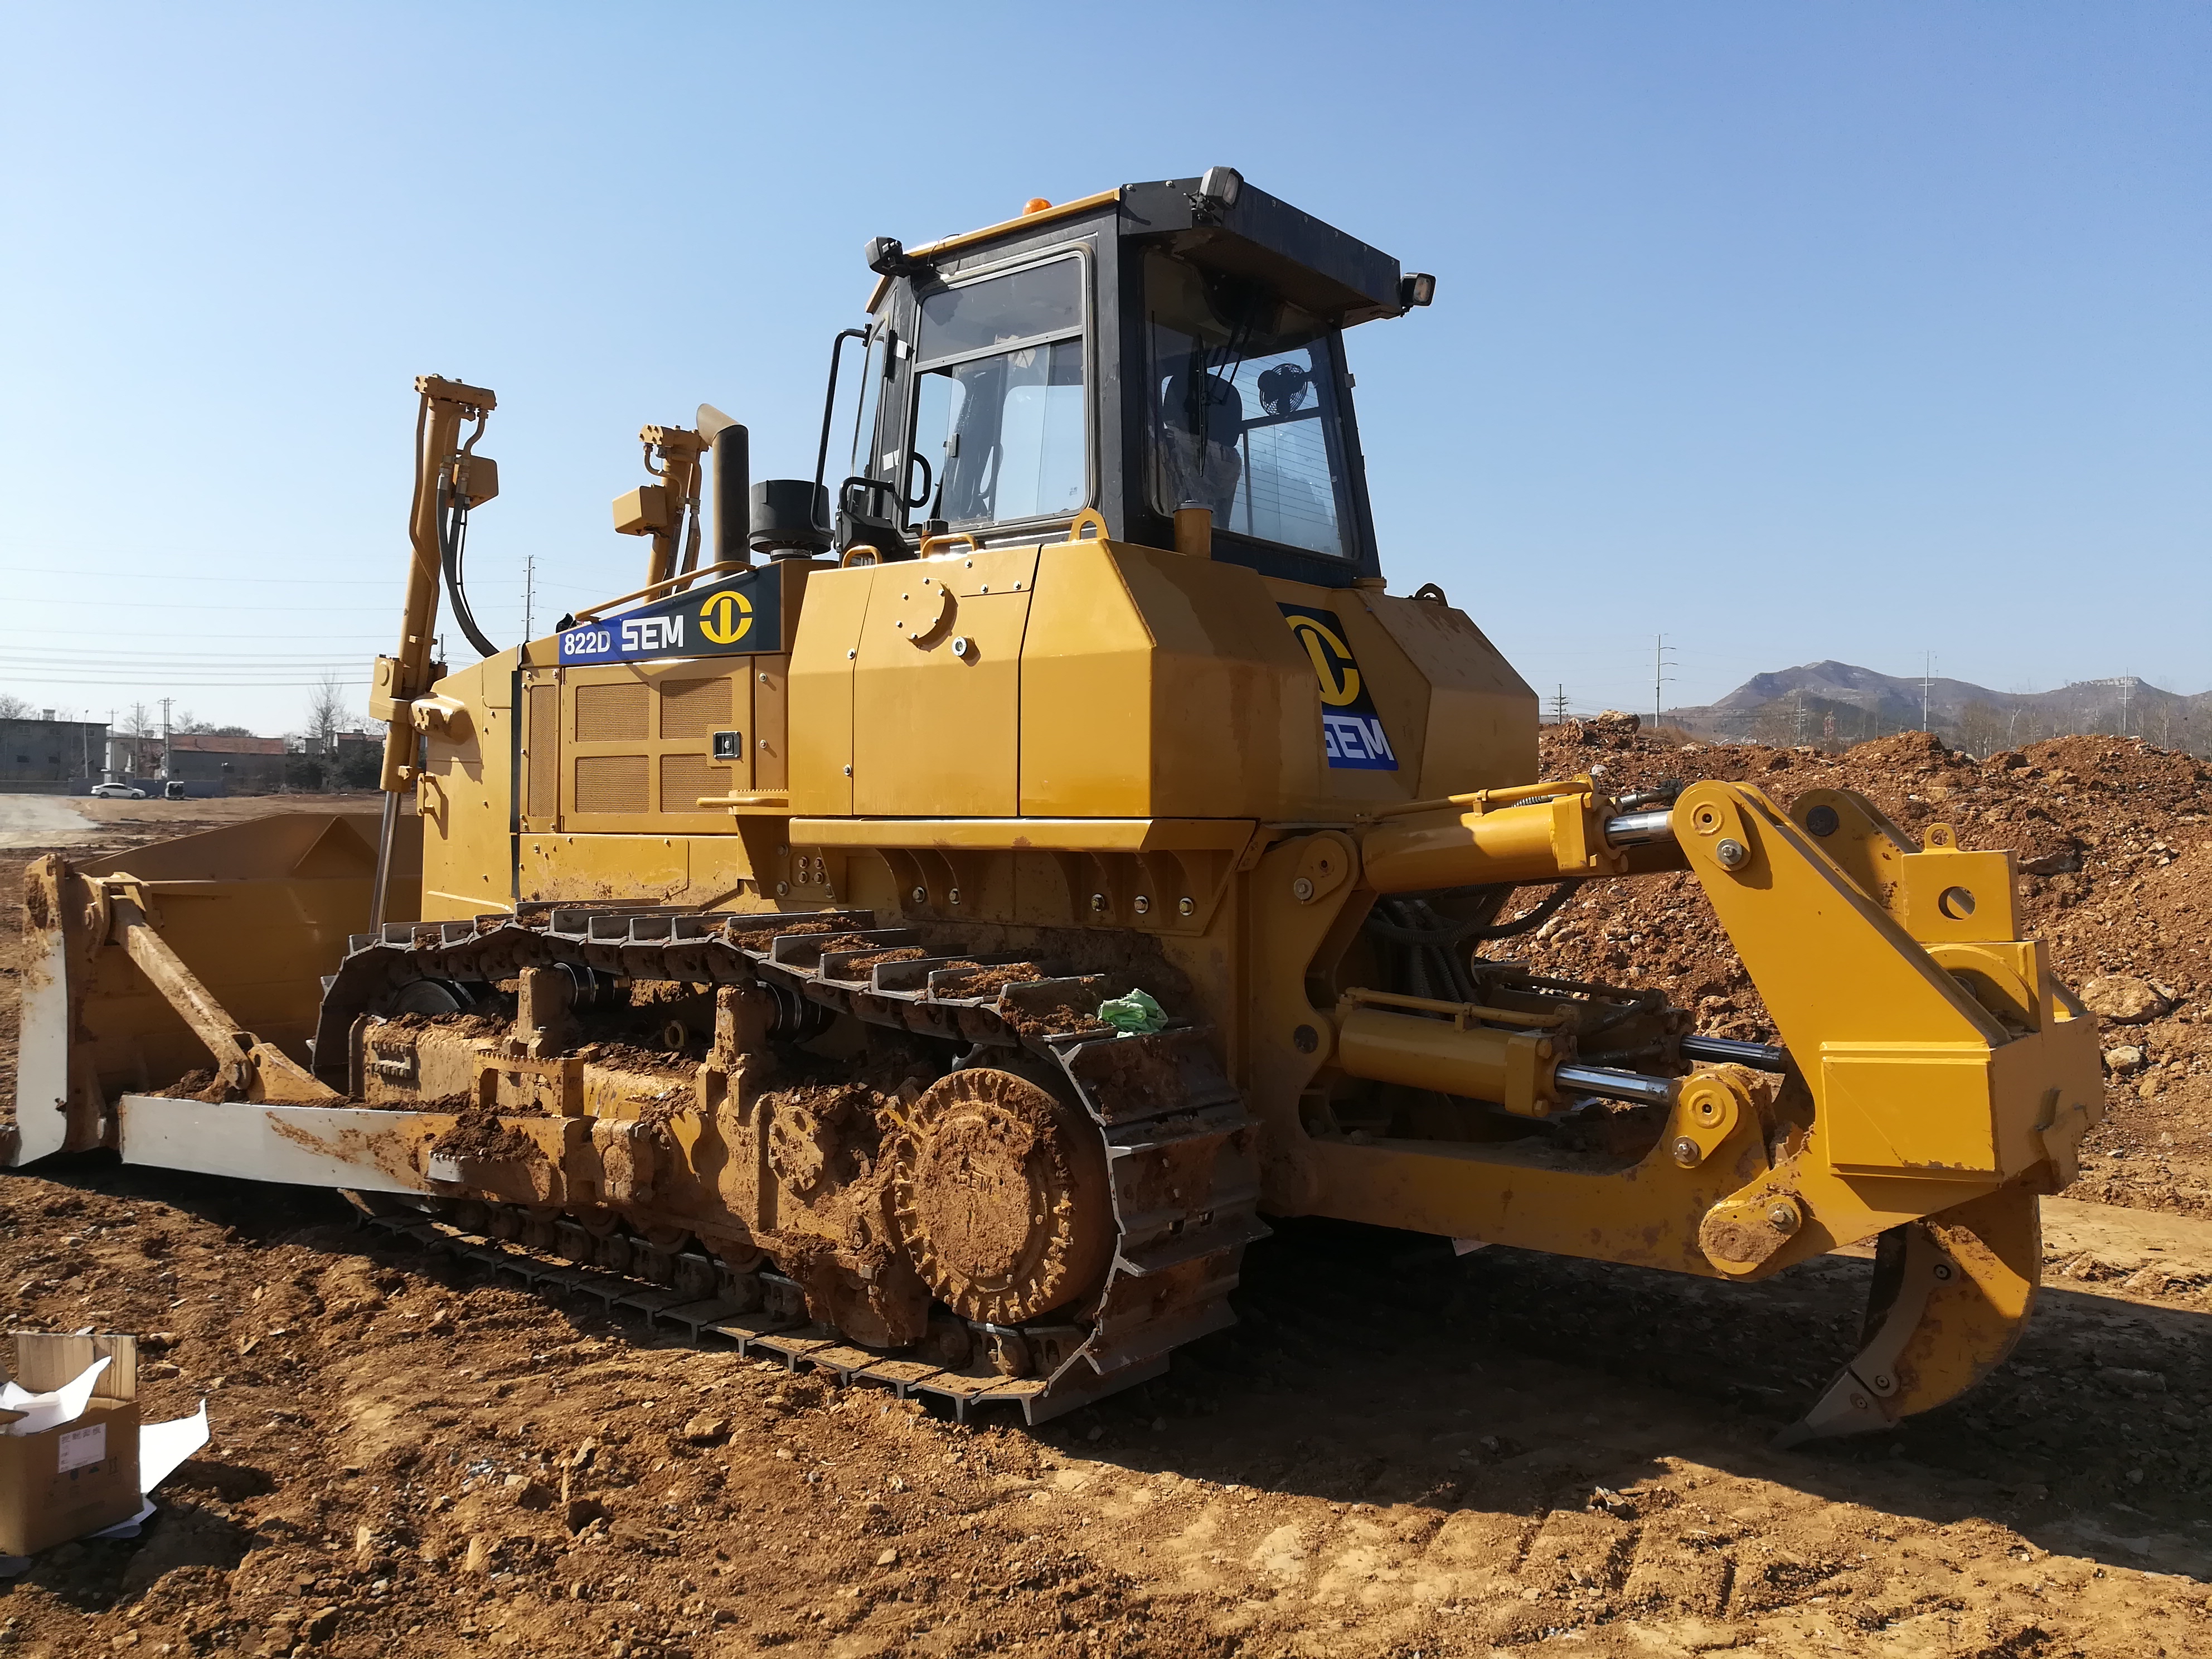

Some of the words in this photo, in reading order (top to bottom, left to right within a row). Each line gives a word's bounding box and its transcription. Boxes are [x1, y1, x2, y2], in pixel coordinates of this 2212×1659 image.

[565, 631, 610, 655] 822D
[622, 615, 683, 651] SEM
[1322, 715, 1394, 760] SEM
